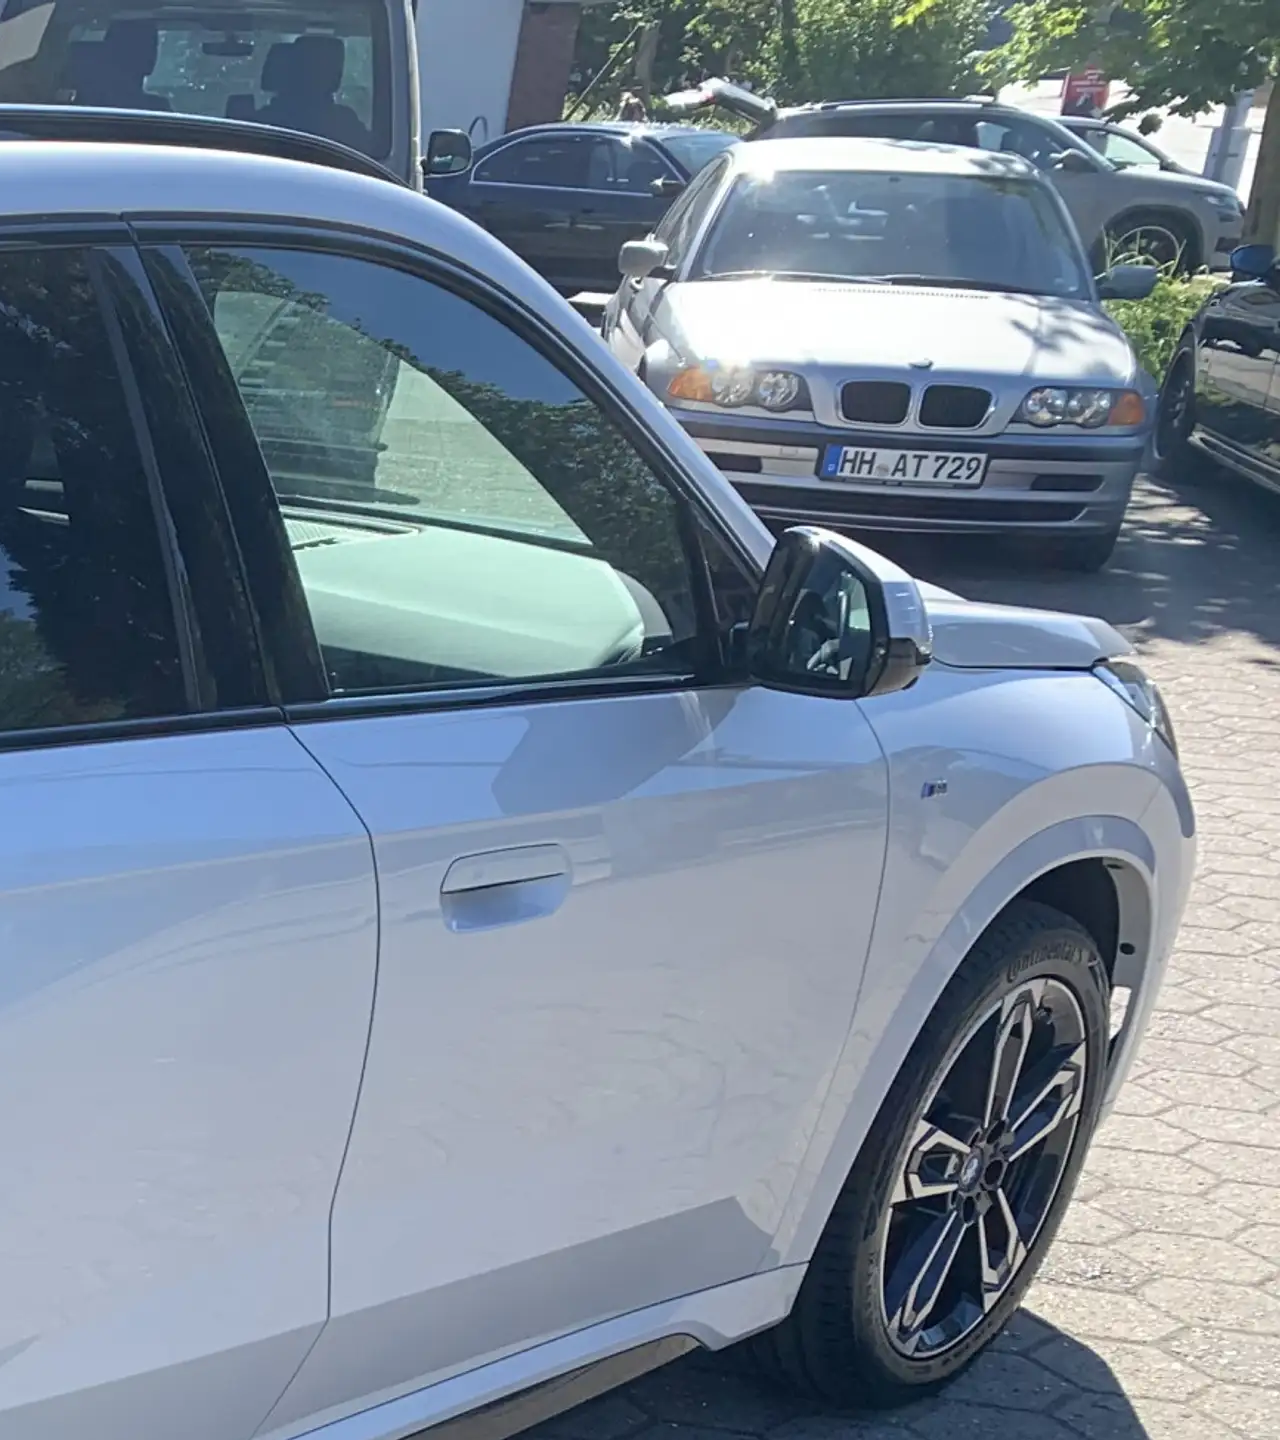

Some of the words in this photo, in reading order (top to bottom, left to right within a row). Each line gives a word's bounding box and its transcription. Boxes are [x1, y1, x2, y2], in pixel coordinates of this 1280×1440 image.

[839, 450, 877, 475] HH
[891, 453, 929, 478] AT
[932, 456, 982, 481] 729
